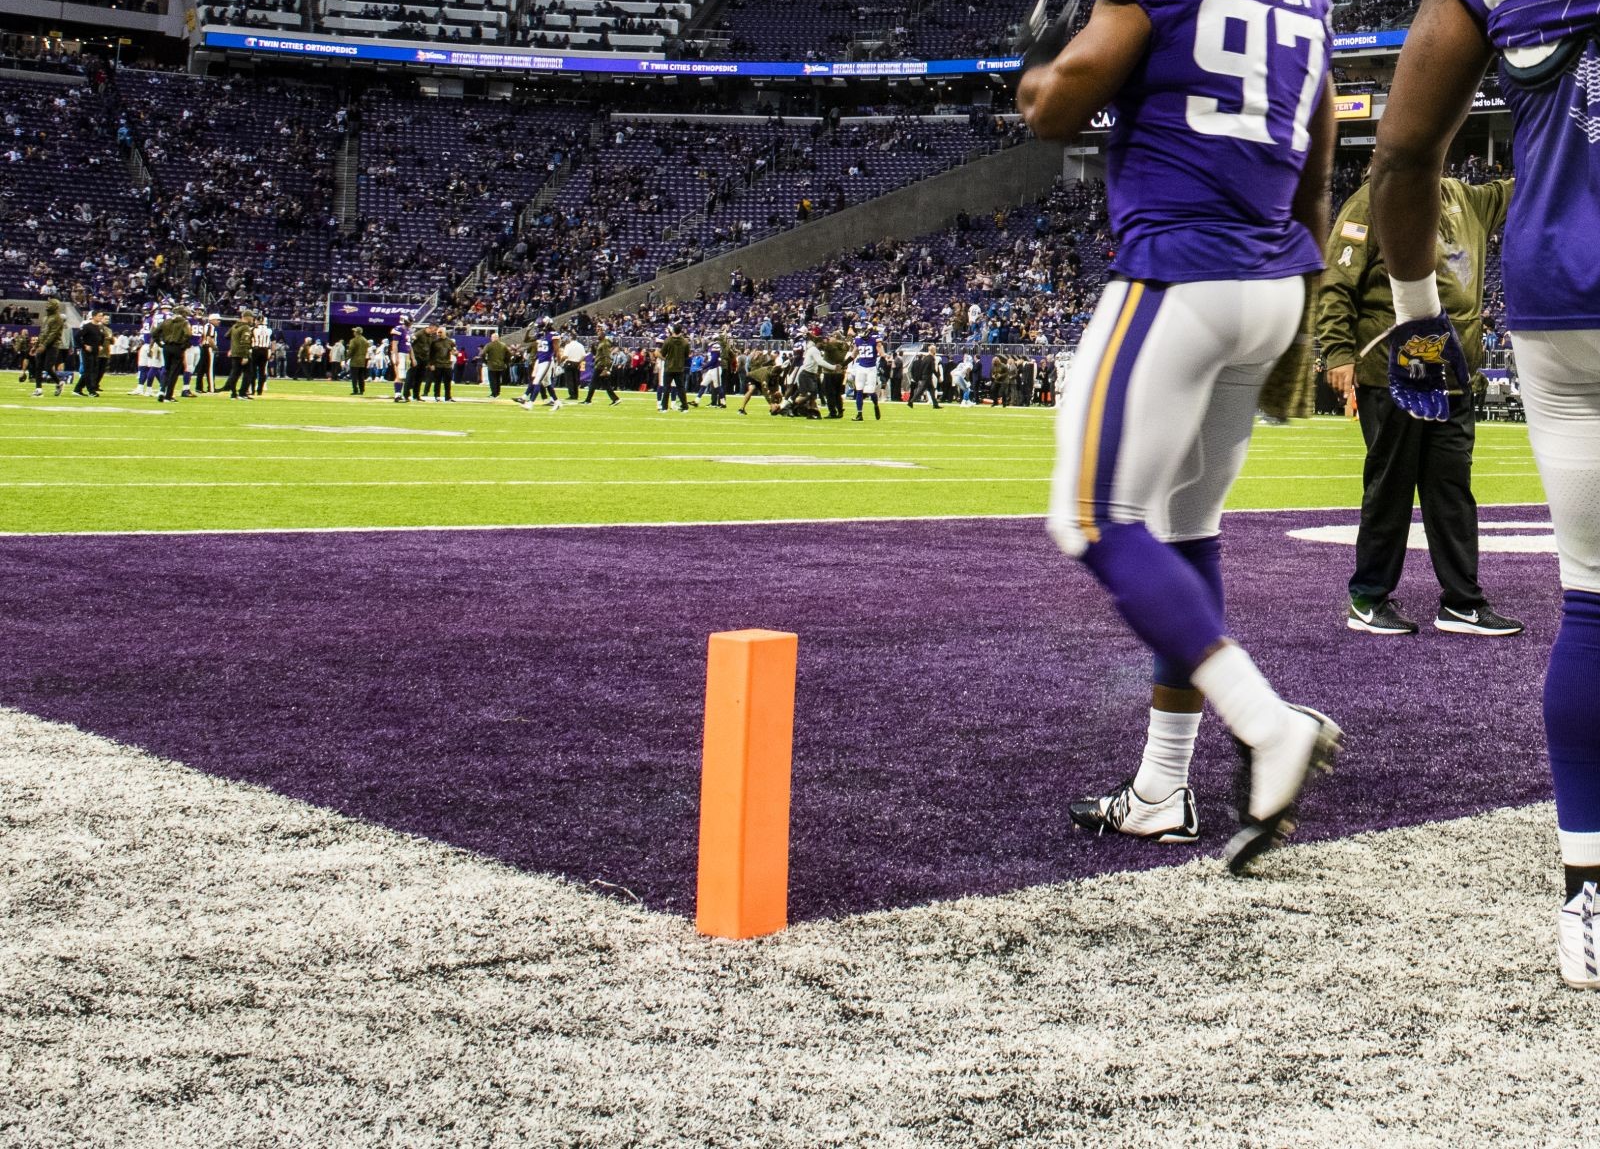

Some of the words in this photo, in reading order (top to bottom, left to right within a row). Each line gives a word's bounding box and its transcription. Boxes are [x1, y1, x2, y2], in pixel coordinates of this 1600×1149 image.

[258, 39, 279, 49] TWIN
[280, 40, 303, 50] CITIES
[305, 42, 357, 55] ORTHOPEDICS
[1333, 36, 1377, 47] ORTHOPEDICS
[650, 62, 667, 72] TWIN
[669, 63, 690, 72] CITIES
[692, 63, 738, 73] ORTHOPEDICS
[1004, 59, 1021, 69] CITIES
[857, 345, 874, 357] 22
